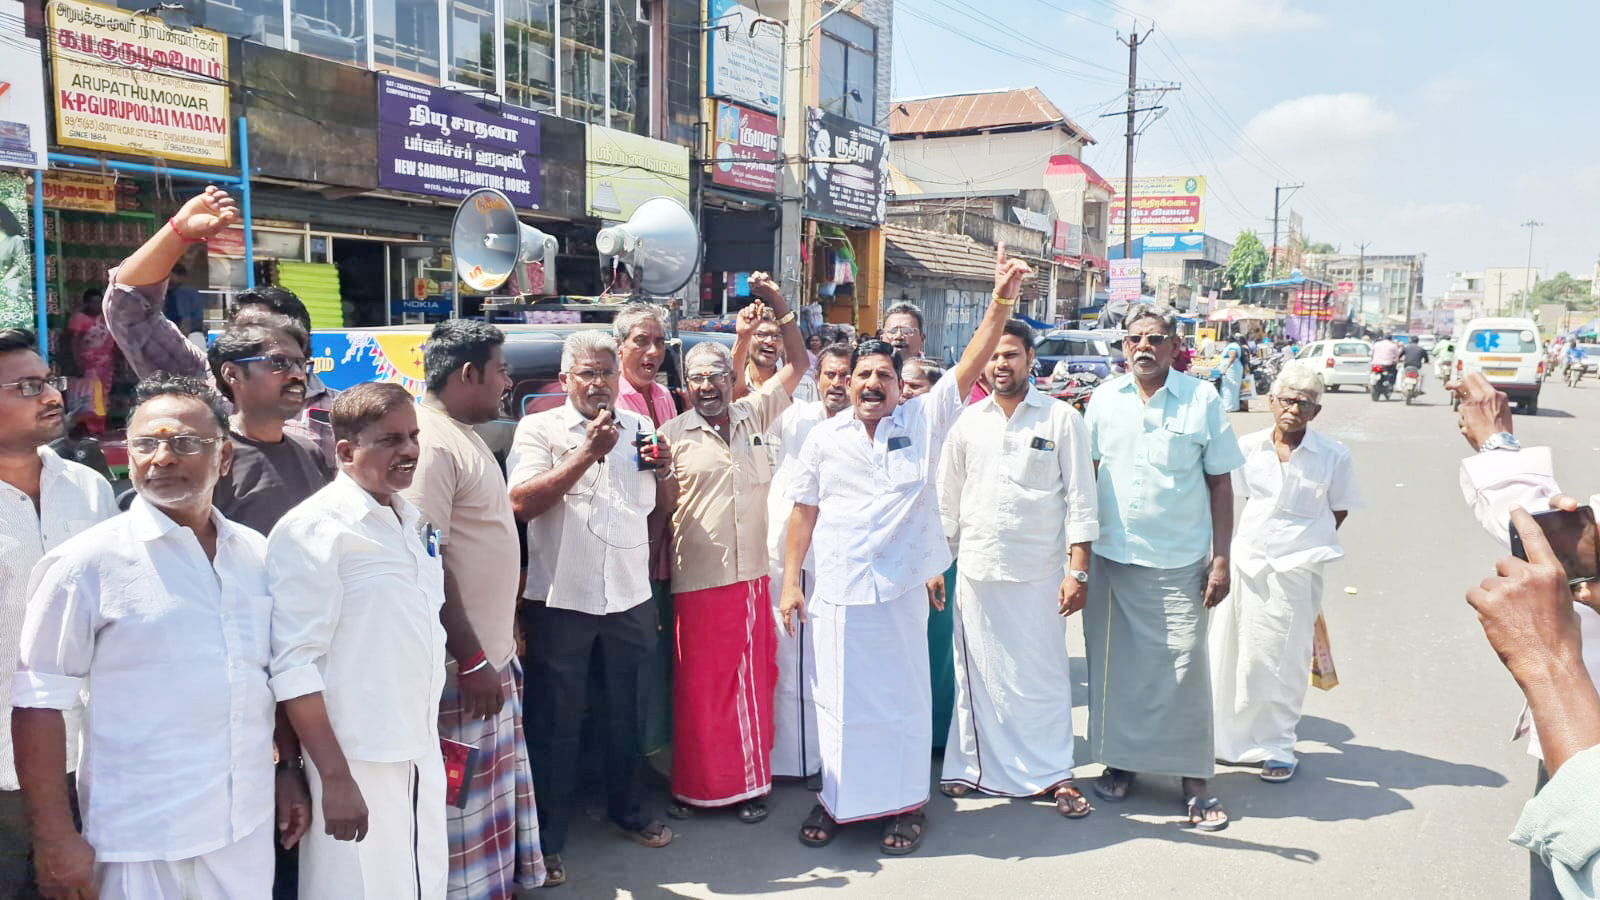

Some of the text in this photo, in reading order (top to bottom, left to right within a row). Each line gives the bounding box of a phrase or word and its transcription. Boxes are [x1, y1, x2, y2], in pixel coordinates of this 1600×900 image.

[72, 74, 149, 100] ARUPATHU
[151, 89, 208, 111] MOOVAR
[171, 110, 226, 134] MADAM
[409, 104, 519, 143] நியூ சாதனா
[394, 158, 531, 194] NEW SADHANA FURNITURE HOUSE
